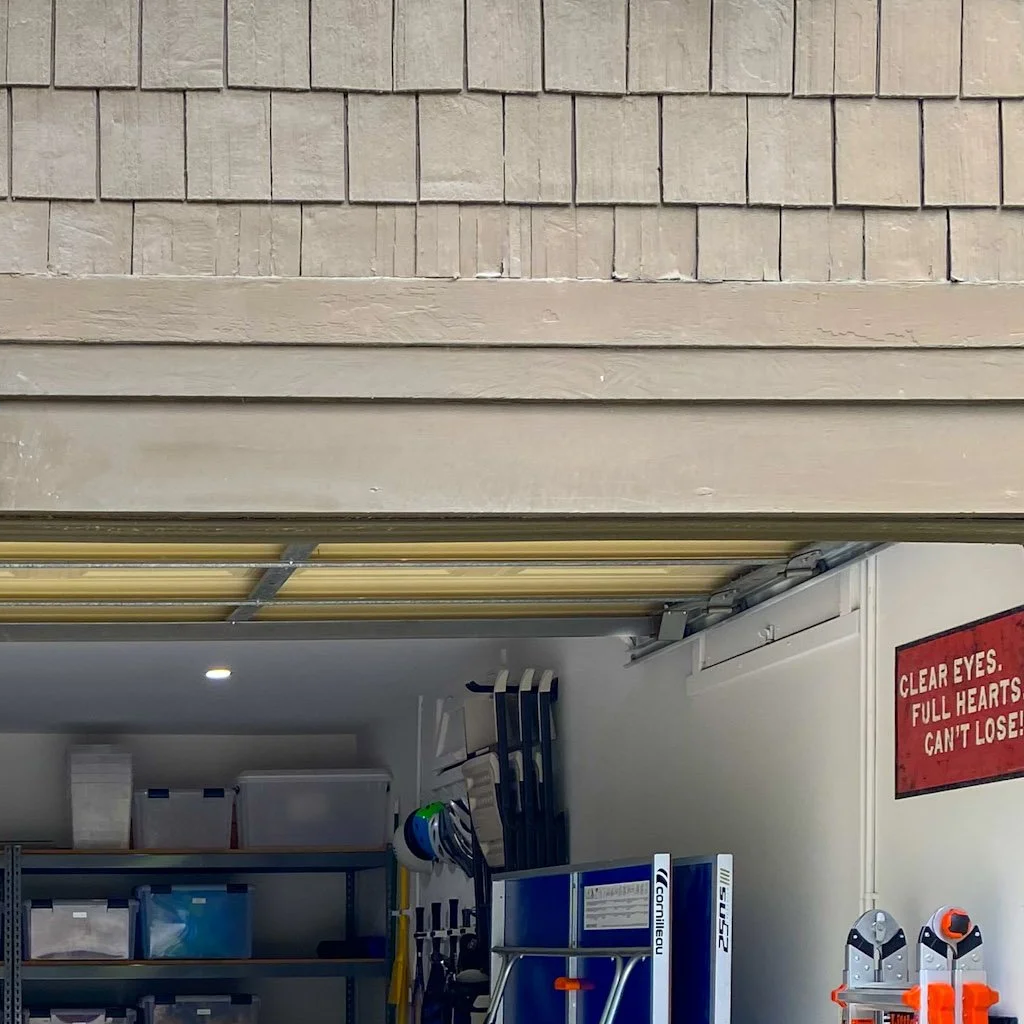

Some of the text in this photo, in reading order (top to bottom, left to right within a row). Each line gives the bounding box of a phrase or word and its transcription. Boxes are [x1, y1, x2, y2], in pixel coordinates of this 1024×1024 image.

[899, 649, 1002, 698] CLEAR EYES.
[912, 695, 951, 727] FULL
[924, 710, 1024, 756] CAN'T LOSE!
